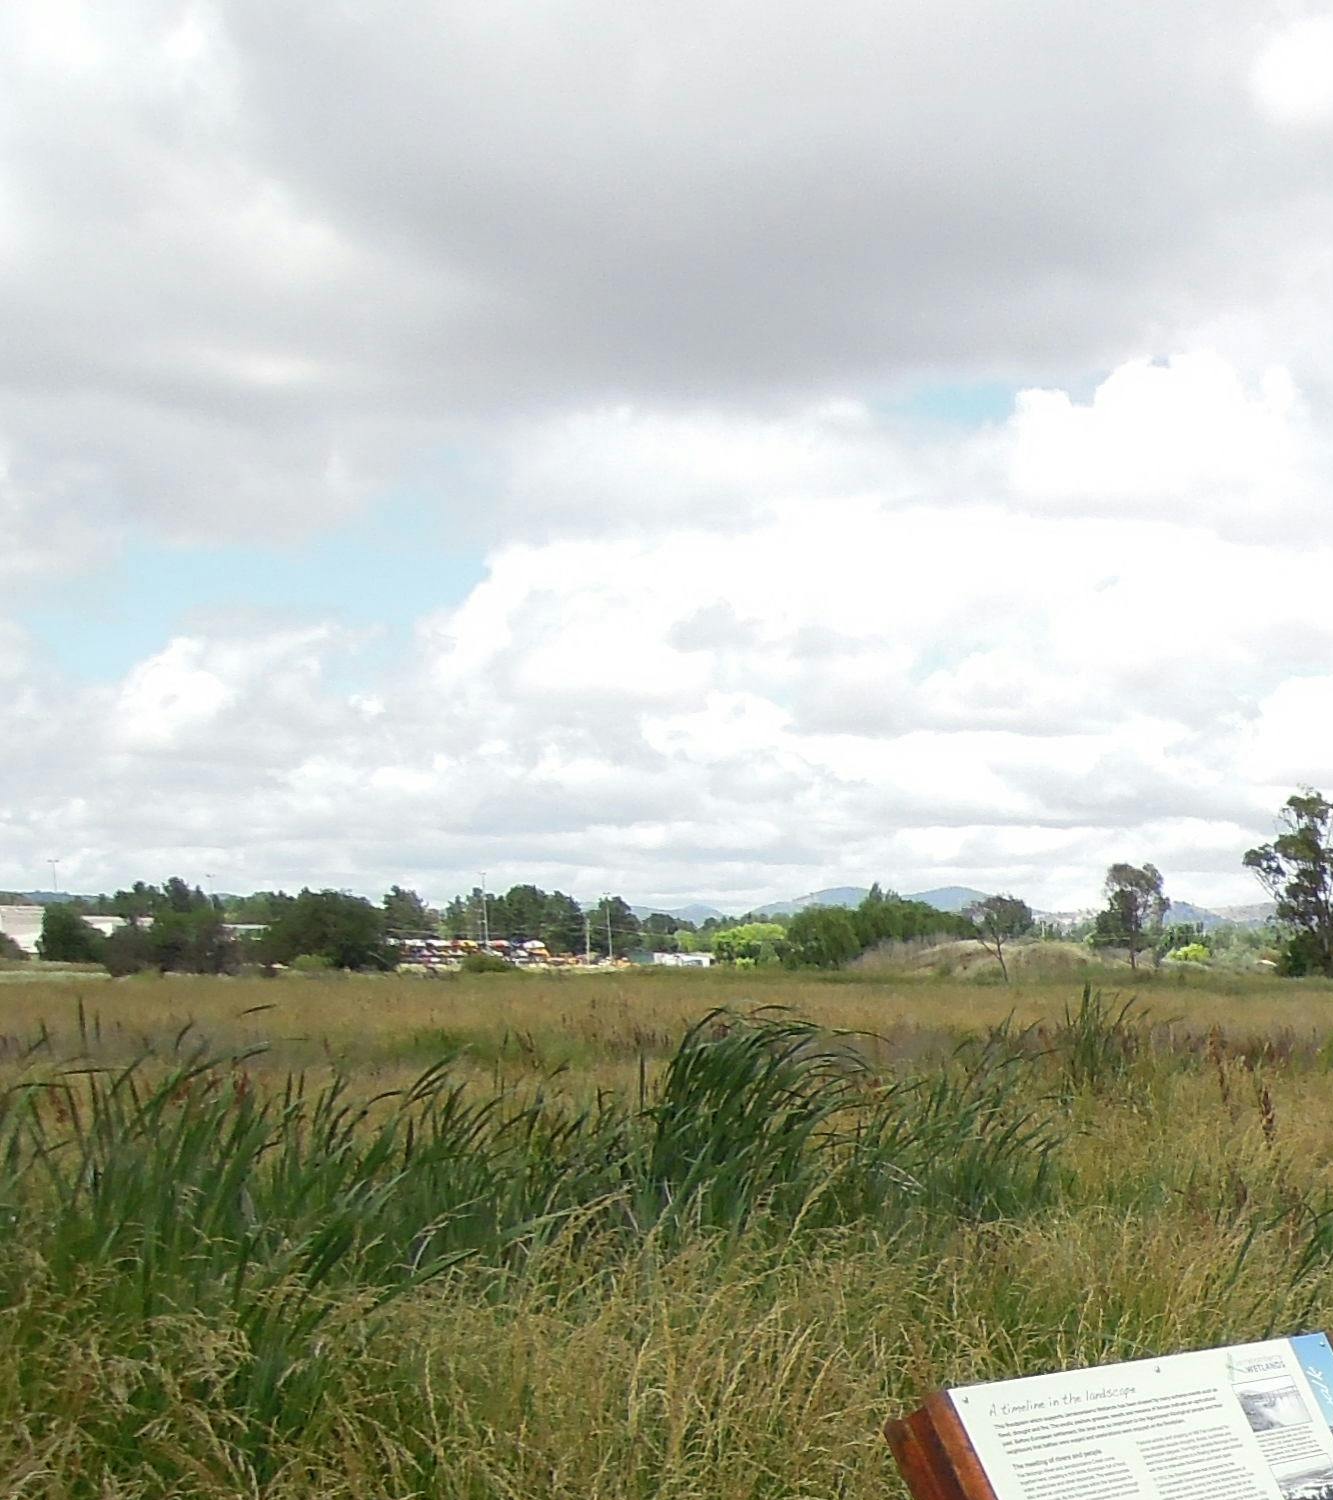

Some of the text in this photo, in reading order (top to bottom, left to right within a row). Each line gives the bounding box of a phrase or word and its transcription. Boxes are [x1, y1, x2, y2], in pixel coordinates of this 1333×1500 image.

[1247, 1361, 1286, 1373] WETLANDS
[989, 1386, 1136, 1417] A timeline in the landscape
